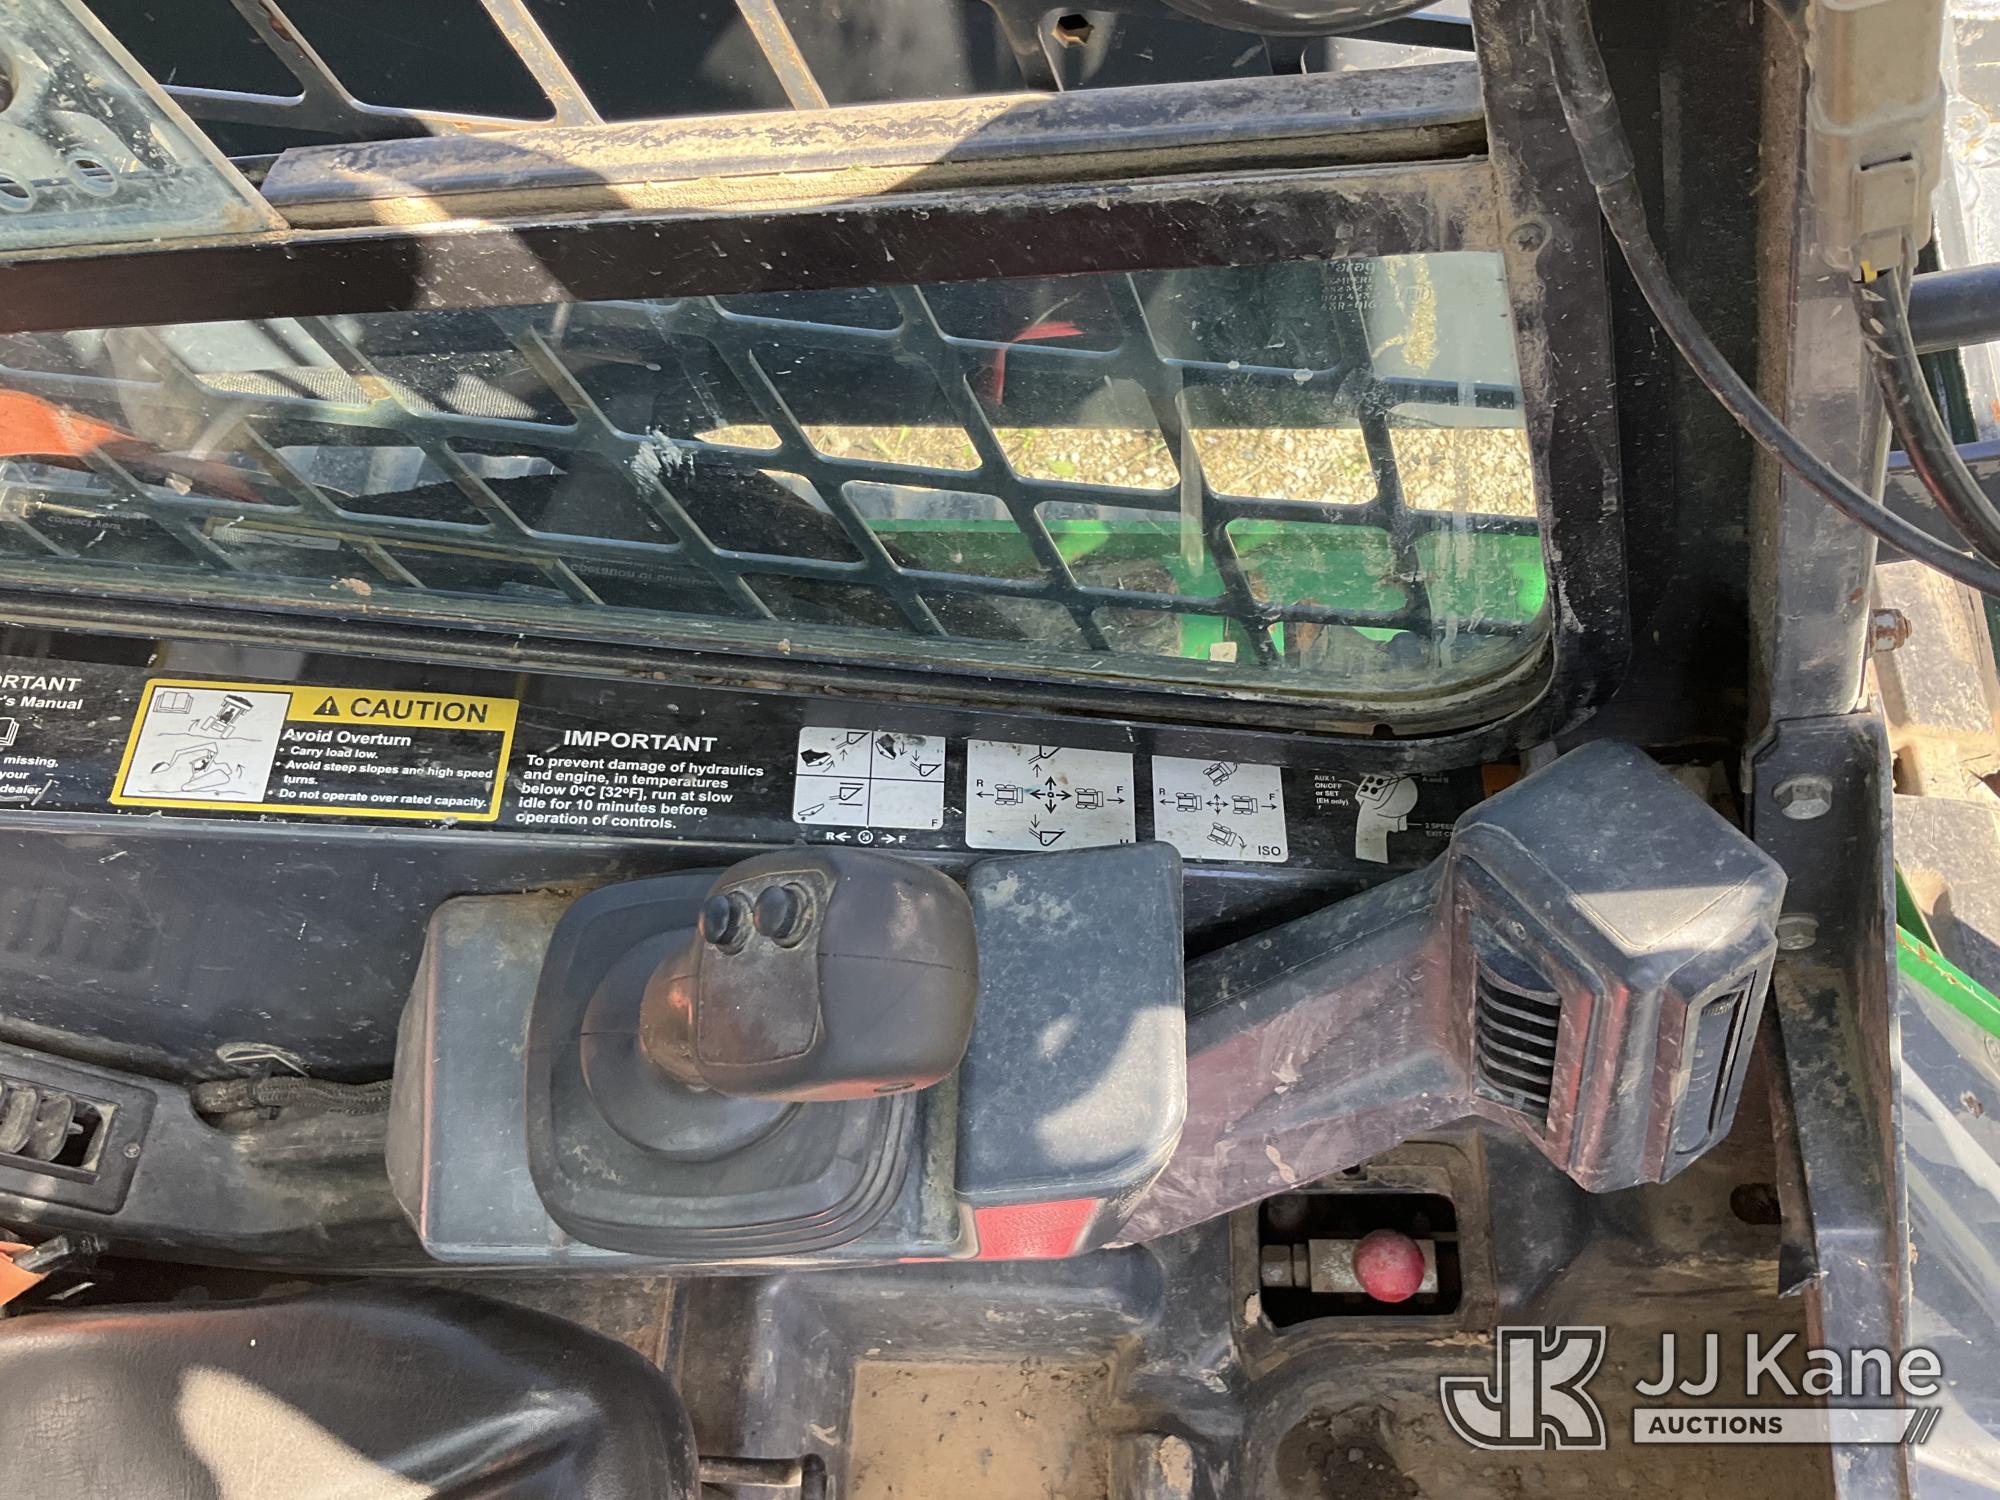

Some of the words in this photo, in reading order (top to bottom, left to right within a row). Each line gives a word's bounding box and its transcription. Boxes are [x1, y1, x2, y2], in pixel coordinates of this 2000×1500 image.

[0, 673, 82, 692] RTANT
[20, 696, 83, 710] Manual
[350, 697, 489, 723] CAUTION
[282, 728, 334, 743] Avoid
[336, 730, 412, 747] Overturn
[563, 729, 719, 753] IMPORTANT
[290, 745, 324, 759] Carry
[326, 747, 353, 758] load
[354, 748, 379, 759] low.
[3, 755, 59, 768] missing,
[526, 754, 545, 767] To
[547, 757, 605, 769] prevent
[607, 759, 667, 775] damage
[669, 762, 687, 773] of
[688, 762, 765, 777] hydraulics
[285, 759, 322, 771] Avoid
[323, 760, 357, 774] steep
[359, 763, 399, 775] slopes
[427, 766, 454, 779] high
[456, 769, 494, 780] speed
[283, 774, 319, 786] turns.
[523, 769, 553, 781] and
[554, 771, 610, 785] engine,
[613, 772, 628, 784] in
[631, 773, 730, 789] temperatures
[976, 779, 984, 787] R
[0, 783, 42, 795] dealer.
[520, 781, 567, 796] below
[651, 790, 677, 801] run
[680, 790, 696, 802] at
[698, 791, 733, 804] slow
[1116, 785, 1124, 794] F
[1159, 787, 1166, 795] R
[279, 788, 297, 799] Do
[299, 791, 320, 800] not
[322, 792, 368, 803] operate
[370, 794, 400, 803] over
[400, 794, 432, 805] rated
[434, 797, 488, 809] capacity.
[1269, 793, 1276, 801] F
[518, 796, 547, 809] idle
[549, 798, 573, 810] for
[575, 798, 594, 811] 10
[596, 800, 657, 814] minutes
[660, 802, 709, 816] before
[591, 814, 609, 826] of
[610, 816, 678, 830] controls.
[931, 818, 939, 827] F
[1257, 845, 1281, 856] ISO
